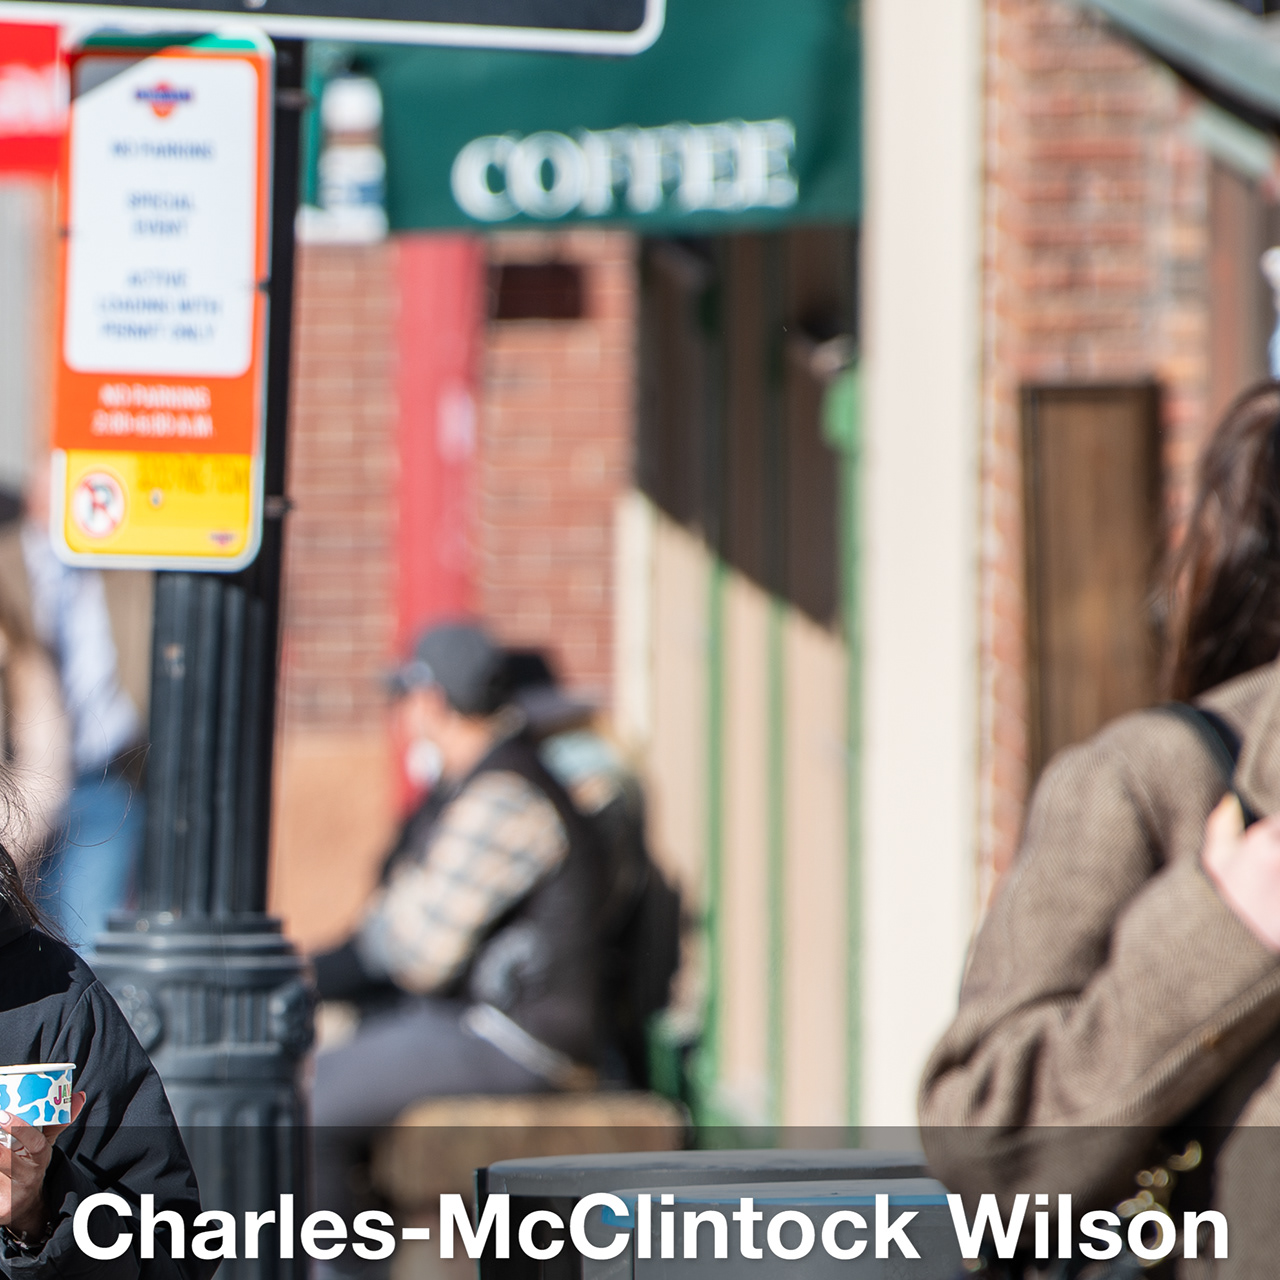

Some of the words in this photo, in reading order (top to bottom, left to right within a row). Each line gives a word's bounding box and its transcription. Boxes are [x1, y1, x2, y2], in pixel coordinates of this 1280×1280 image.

[141, 141, 212, 160] PARKING
[451, 118, 798, 220] COFFEE
[100, 384, 130, 408] NO
[132, 385, 210, 409] PARKING
